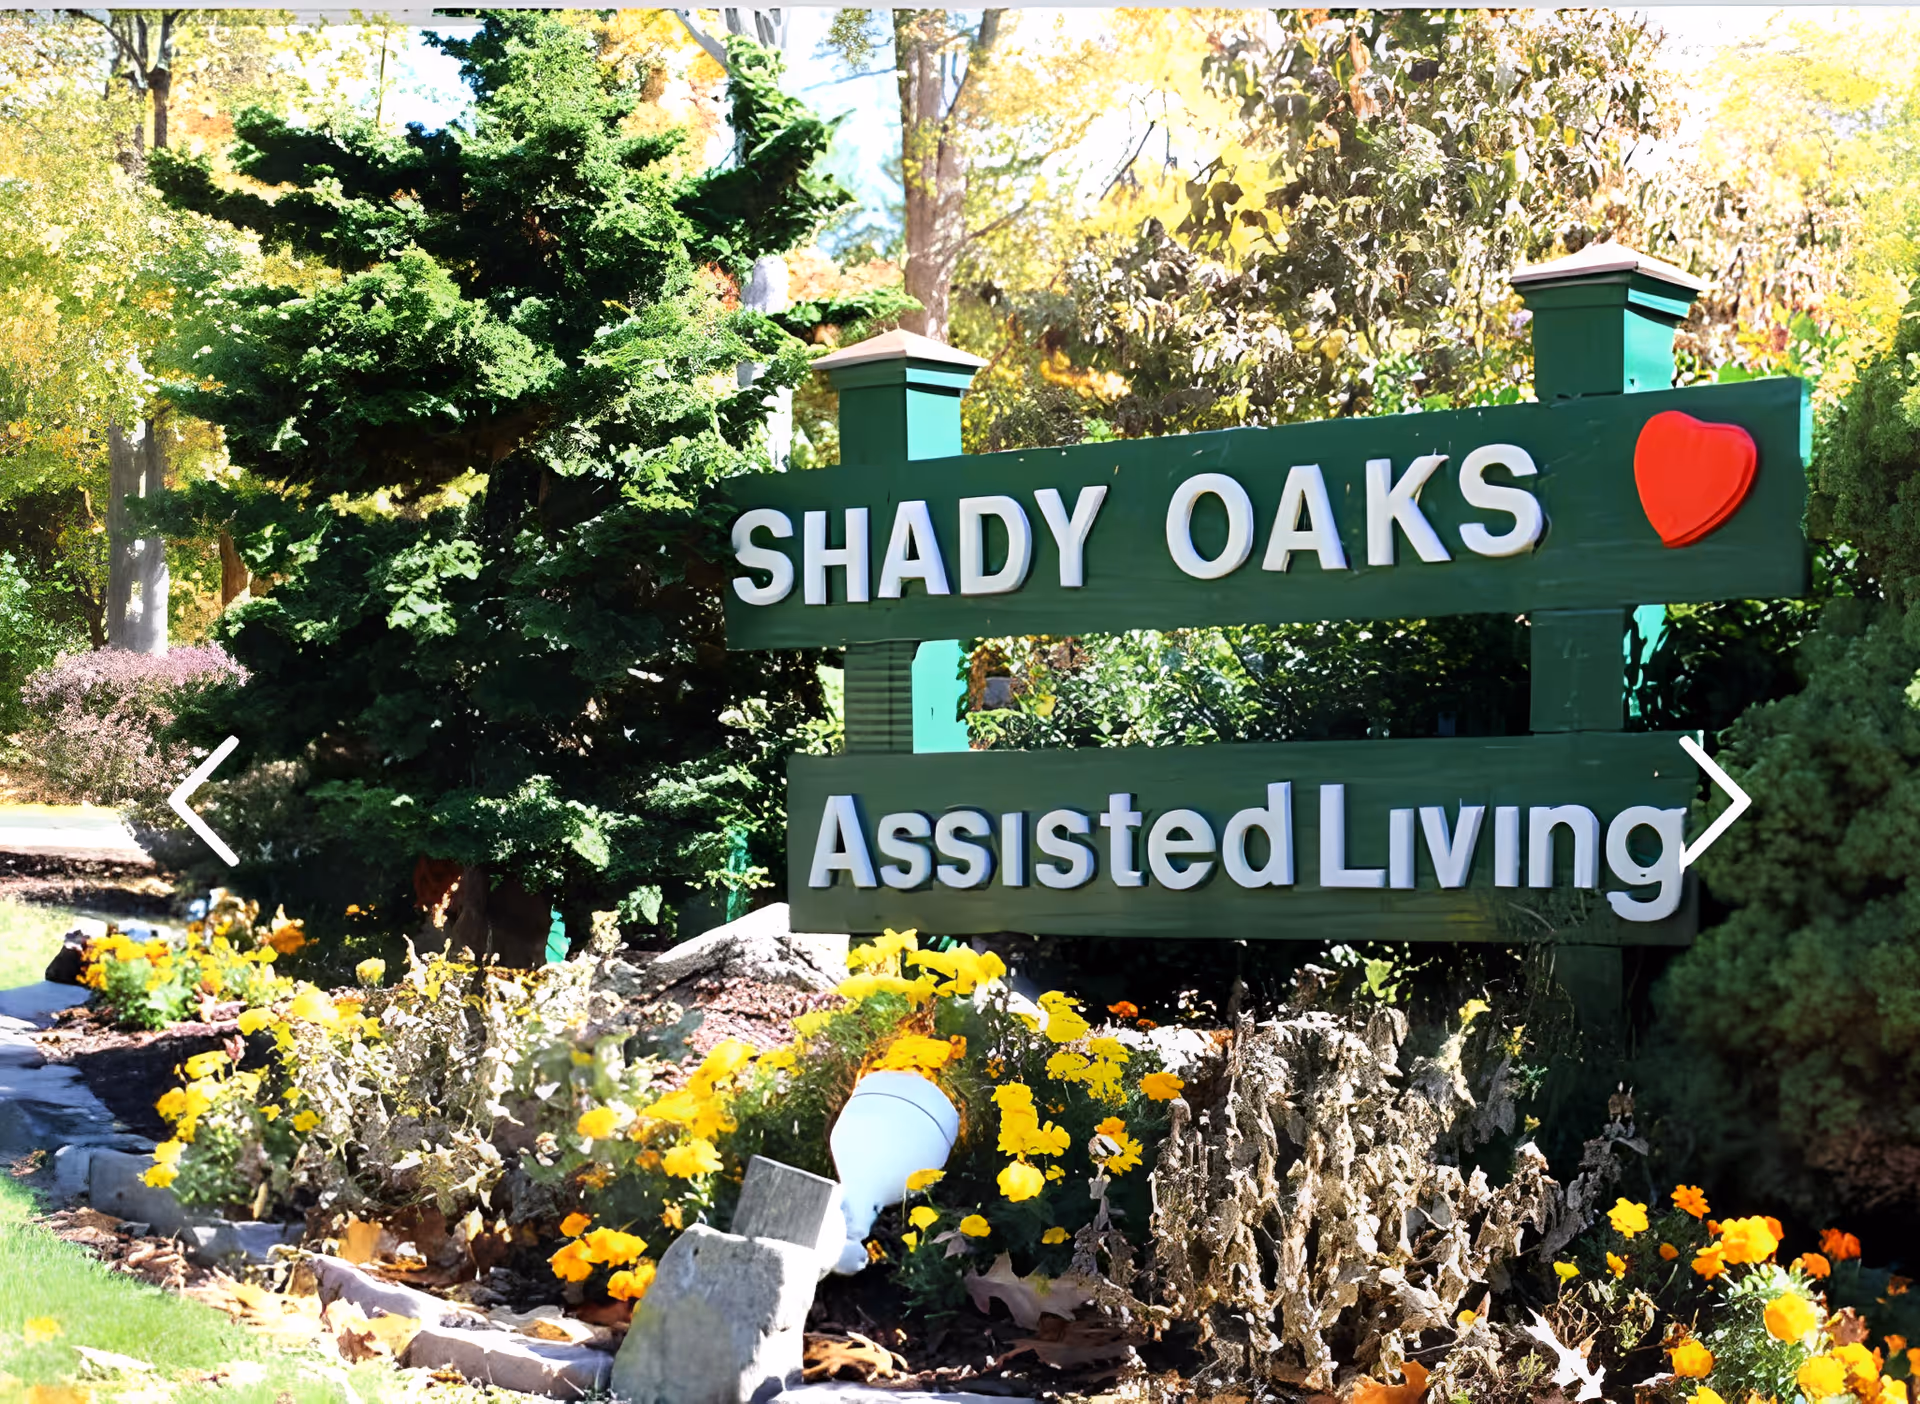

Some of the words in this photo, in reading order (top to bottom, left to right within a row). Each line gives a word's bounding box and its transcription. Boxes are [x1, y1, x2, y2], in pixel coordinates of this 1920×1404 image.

[731, 485, 1107, 606] SHADY
[1166, 443, 1544, 579] OAKS
[808, 781, 1294, 891] Assisted
[1319, 783, 1687, 922] Living
